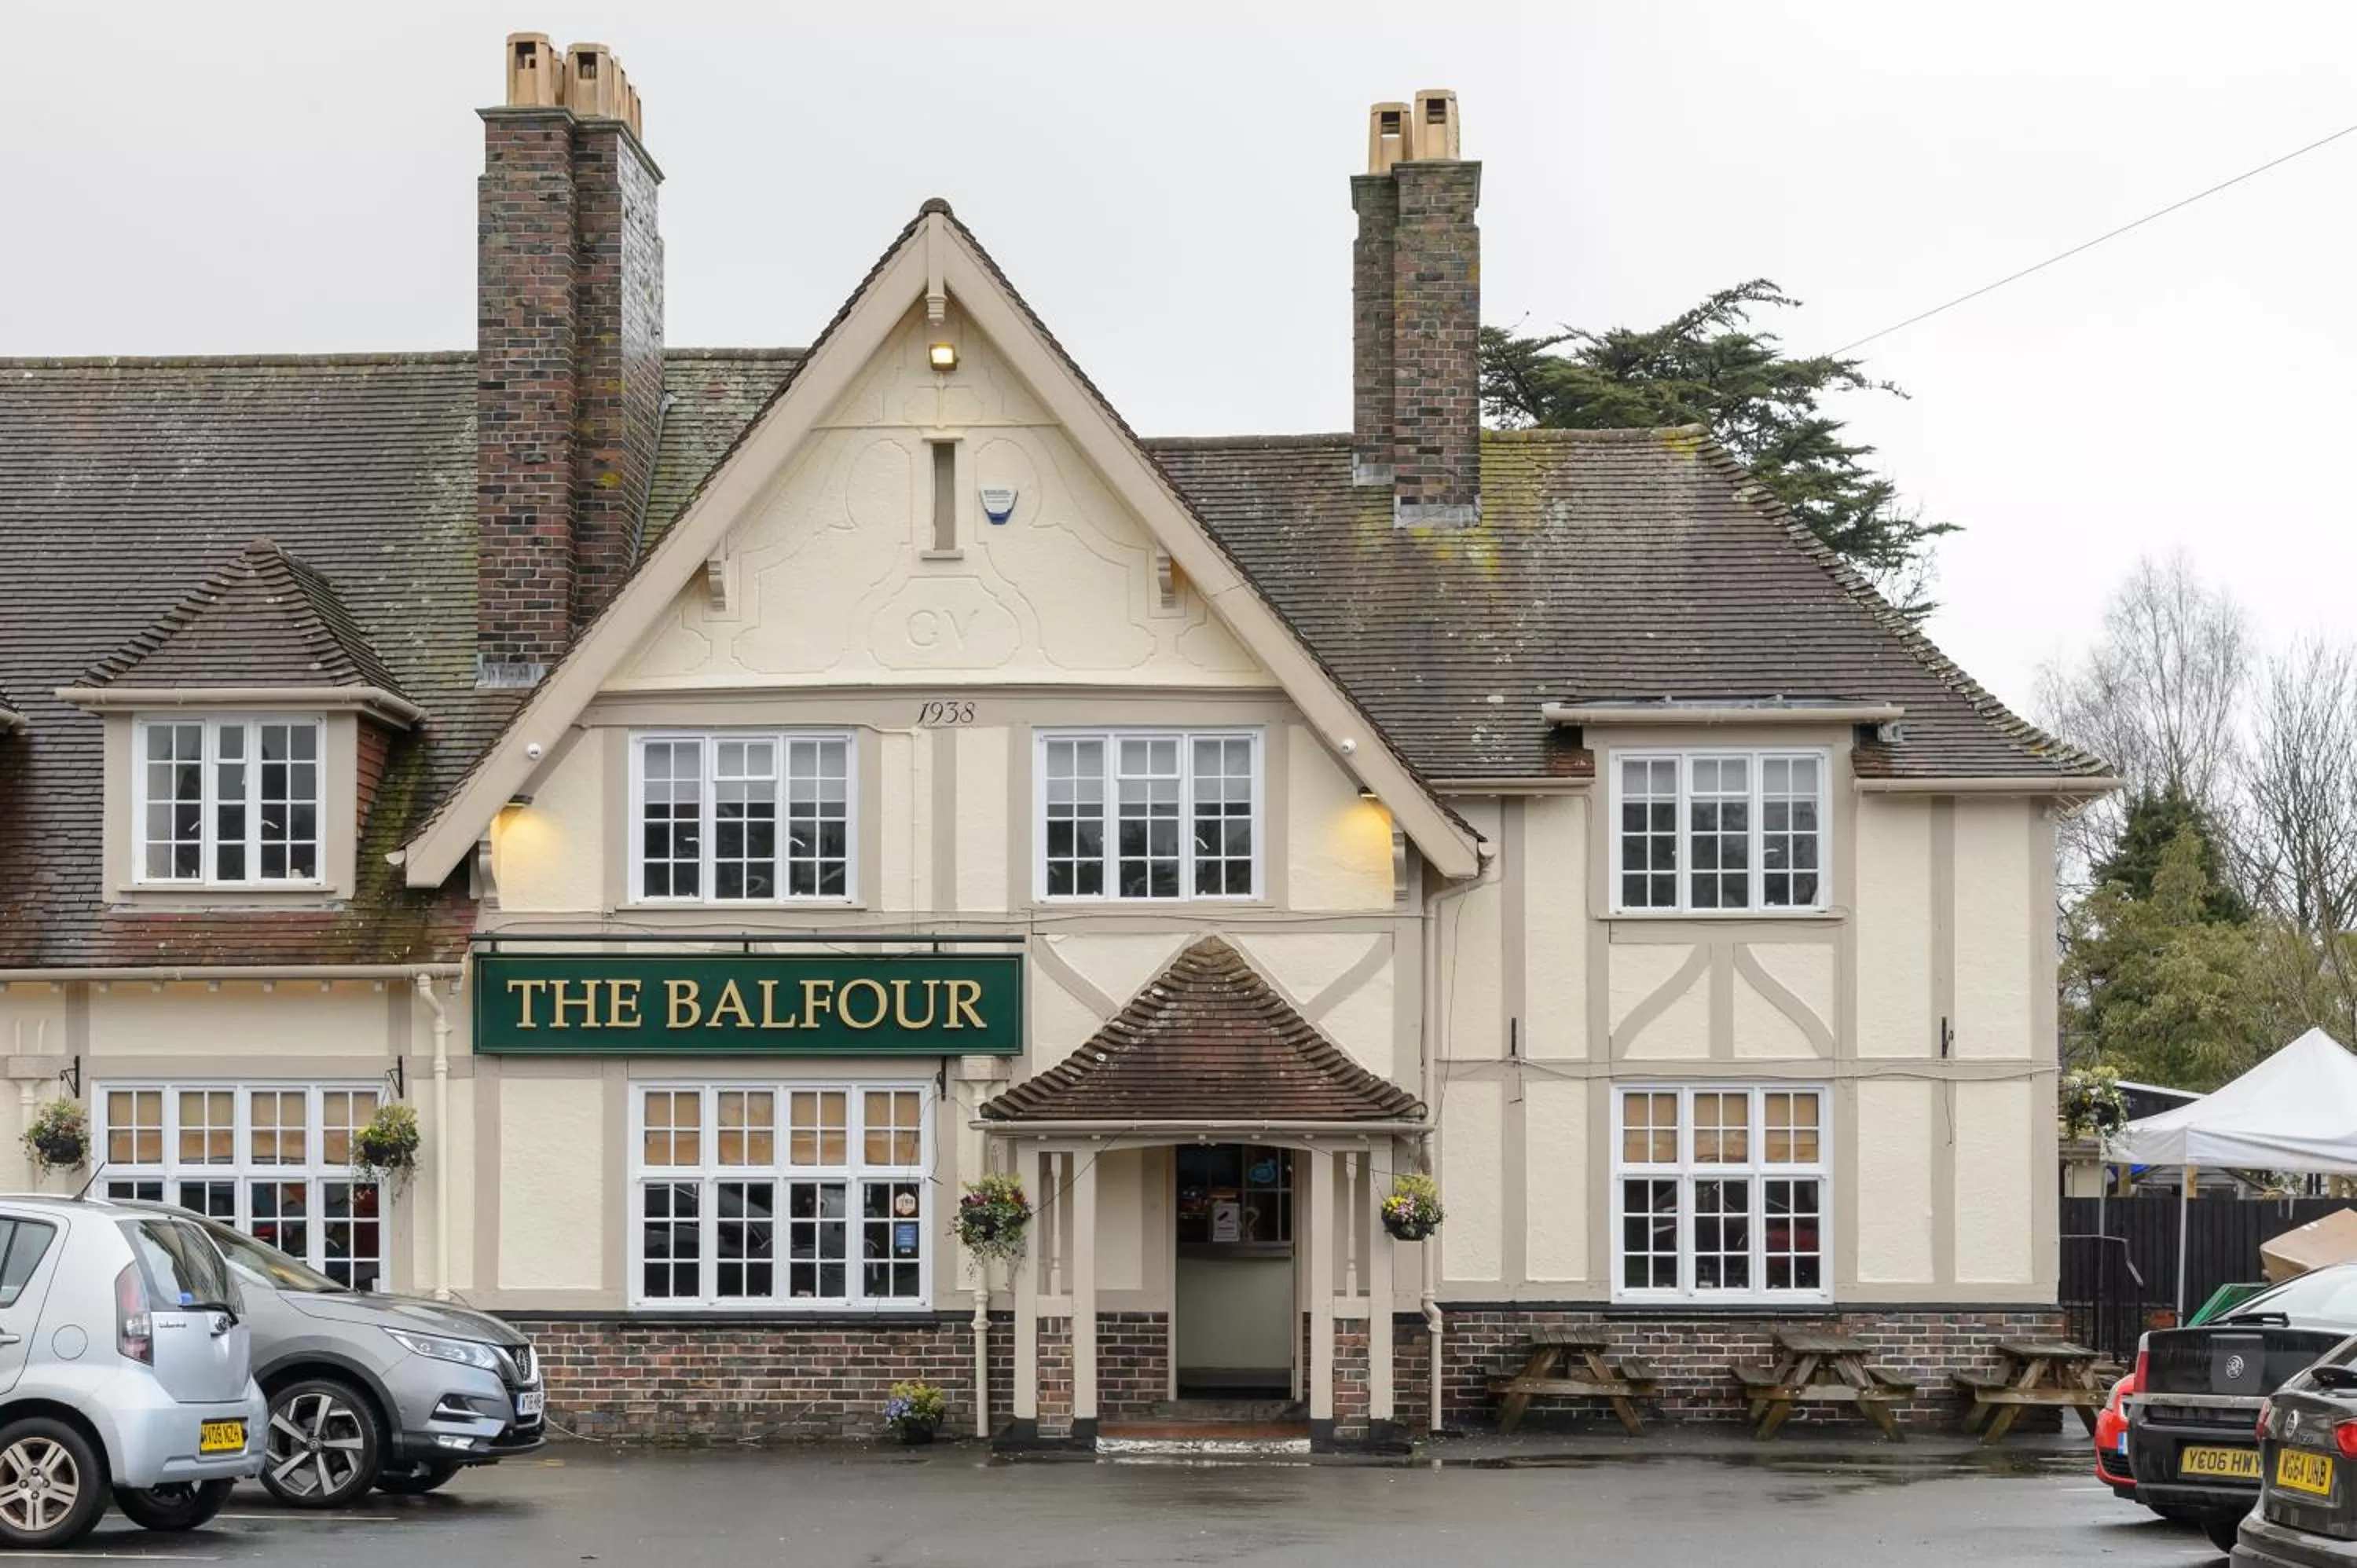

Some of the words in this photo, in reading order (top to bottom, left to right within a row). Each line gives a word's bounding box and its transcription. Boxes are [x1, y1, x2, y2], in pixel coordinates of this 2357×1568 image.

[917, 702, 975, 724] 1938
[507, 980, 642, 1028] THE
[663, 978, 987, 1029] BALFOUR
